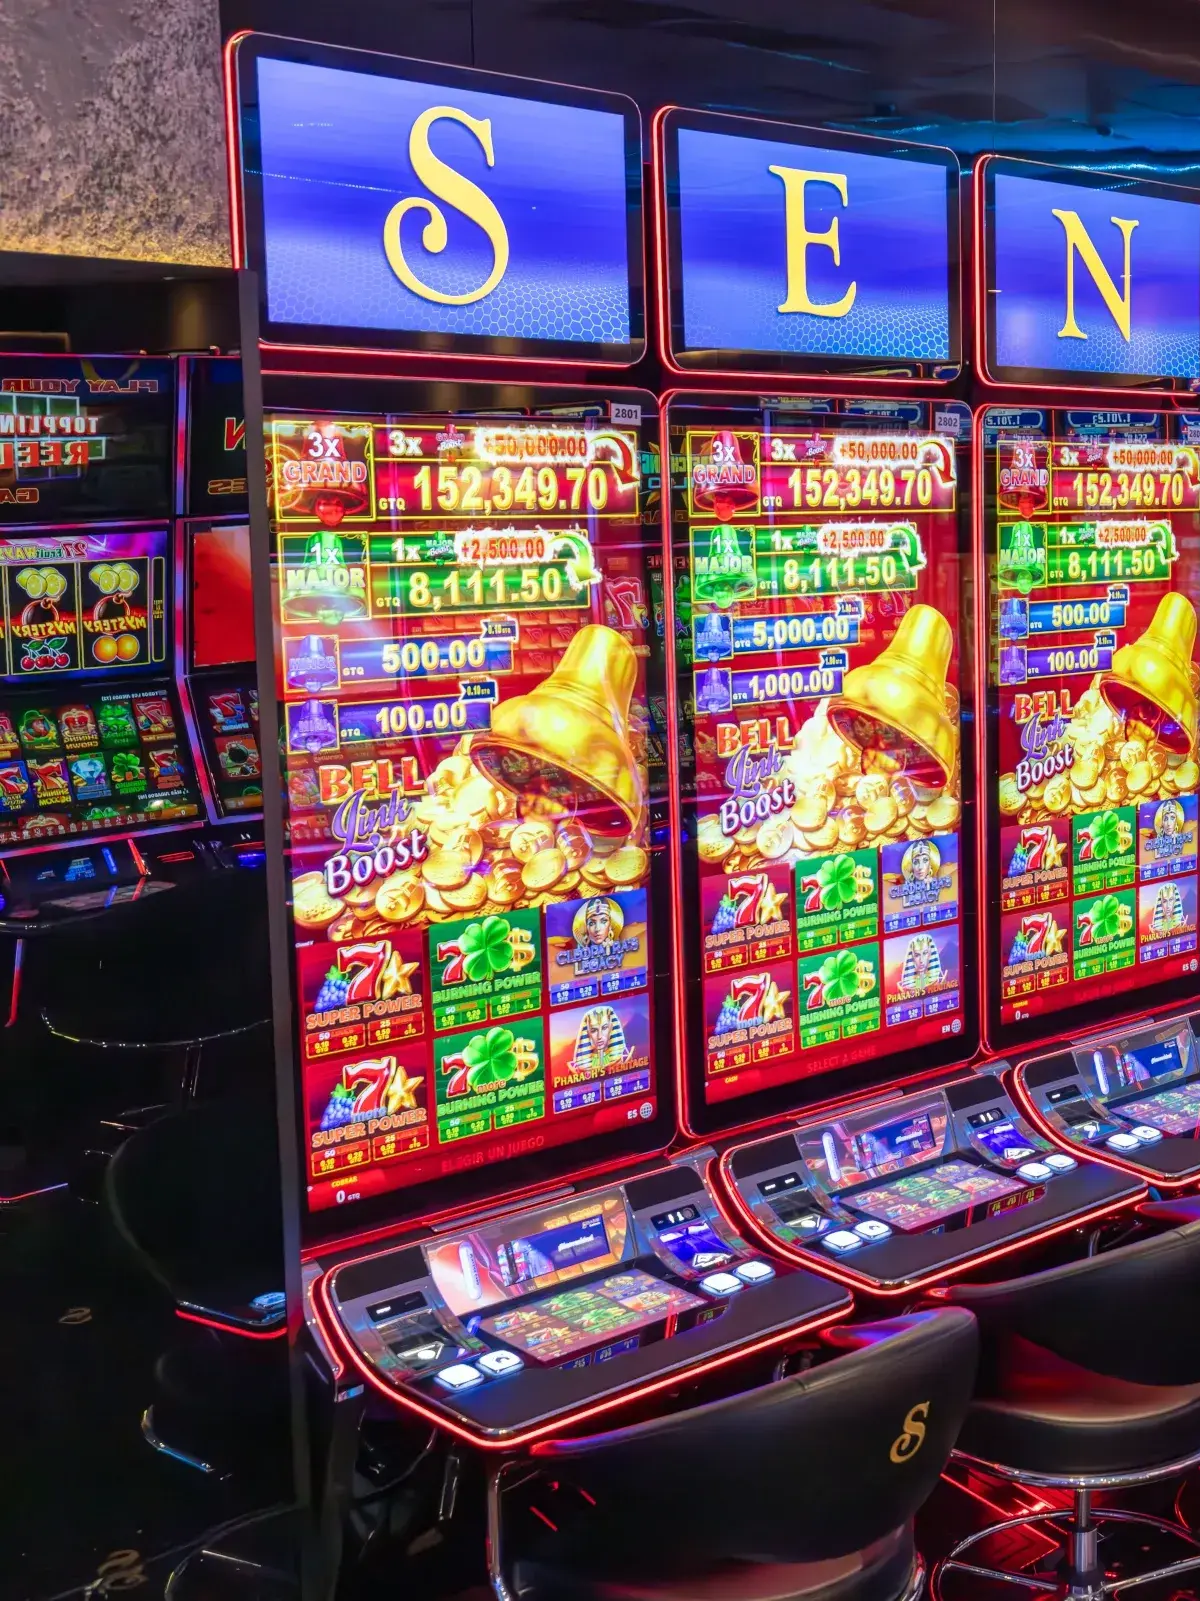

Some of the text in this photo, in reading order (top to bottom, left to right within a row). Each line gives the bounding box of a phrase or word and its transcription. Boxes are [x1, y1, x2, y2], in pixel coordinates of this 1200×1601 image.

[384, 105, 509, 306] S
[769, 164, 857, 318] E
[1052, 208, 1139, 341] N
[614, 407, 638, 420] 2801
[938, 416, 958, 428] 2802
[308, 432, 339, 457] 3x
[389, 430, 423, 456] 3x
[712, 441, 735, 462] 3x
[771, 438, 797, 461] 3x
[839, 442, 918, 463] +50,000.00
[1014, 448, 1033, 468] 3x
[1060, 447, 1079, 466] 3x
[1112, 450, 1173, 467] +50,000.00
[283, 460, 367, 484] GRAND
[693, 464, 756, 484] GRAND
[1000, 469, 1049, 487] GRAND
[379, 465, 608, 515] GTQ 152,349.70
[763, 468, 932, 511] GTQ 152,349.70
[1053, 472, 1184, 510] GTQ 152,349.70
[713, 535, 734, 554] 1x
[771, 530, 793, 551] 1x
[822, 530, 884, 550] +2,500.00
[1014, 531, 1031, 547] 1x
[1060, 526, 1076, 544] 1x
[1098, 528, 1146, 545] +2,500.00
[311, 542, 340, 565] 1x
[391, 537, 421, 562] 1x
[461, 538, 545, 562] +2,500.00
[1000, 548, 1046, 566] MAJOR
[695, 556, 753, 575] MAJOR
[784, 556, 897, 593] 8,111.50
[1068, 550, 1155, 581] 8,111.50
[286, 567, 366, 590] MAJOR
[376, 567, 562, 612] GTQ 8,111.50
[1052, 602, 1110, 627] 500.00
[753, 616, 849, 649] 5,000.00
[343, 639, 486, 676] GTQ 500.00
[1048, 649, 1099, 673] 100.00
[749, 670, 835, 701] 1,000.00
[1014, 688, 1076, 725] BELL
[341, 701, 467, 738] GTQ 100.00
[717, 716, 796, 757] BELL
[725, 744, 784, 800] Link
[1016, 742, 1073, 793] Boost
[319, 756, 429, 805] BELL
[721, 778, 797, 837] Boost
[332, 788, 413, 855] Link
[325, 827, 430, 898] Boost
[1002, 867, 1068, 890] SUPER POWER
[843, 902, 878, 920] POWER
[705, 919, 790, 949] SUPER POWER
[574, 953, 625, 976] LEGACY
[1003, 953, 1068, 978] SUPER POWER
[432, 971, 541, 1004] BURNING POWER
[306, 1006, 361, 1030] SUPER
[363, 994, 422, 1018] POWER
[845, 996, 880, 1015] POWER
[708, 1018, 792, 1050] SUPER POWER
[942, 1025, 951, 1033] EN
[553, 1067, 606, 1088] PHARAOH'S
[806, 1056, 840, 1074] SELECT
[437, 1080, 544, 1117] BURNING POWER
[312, 1108, 427, 1148] SUPER POWER
[507, 1135, 545, 1161] JUEGO
